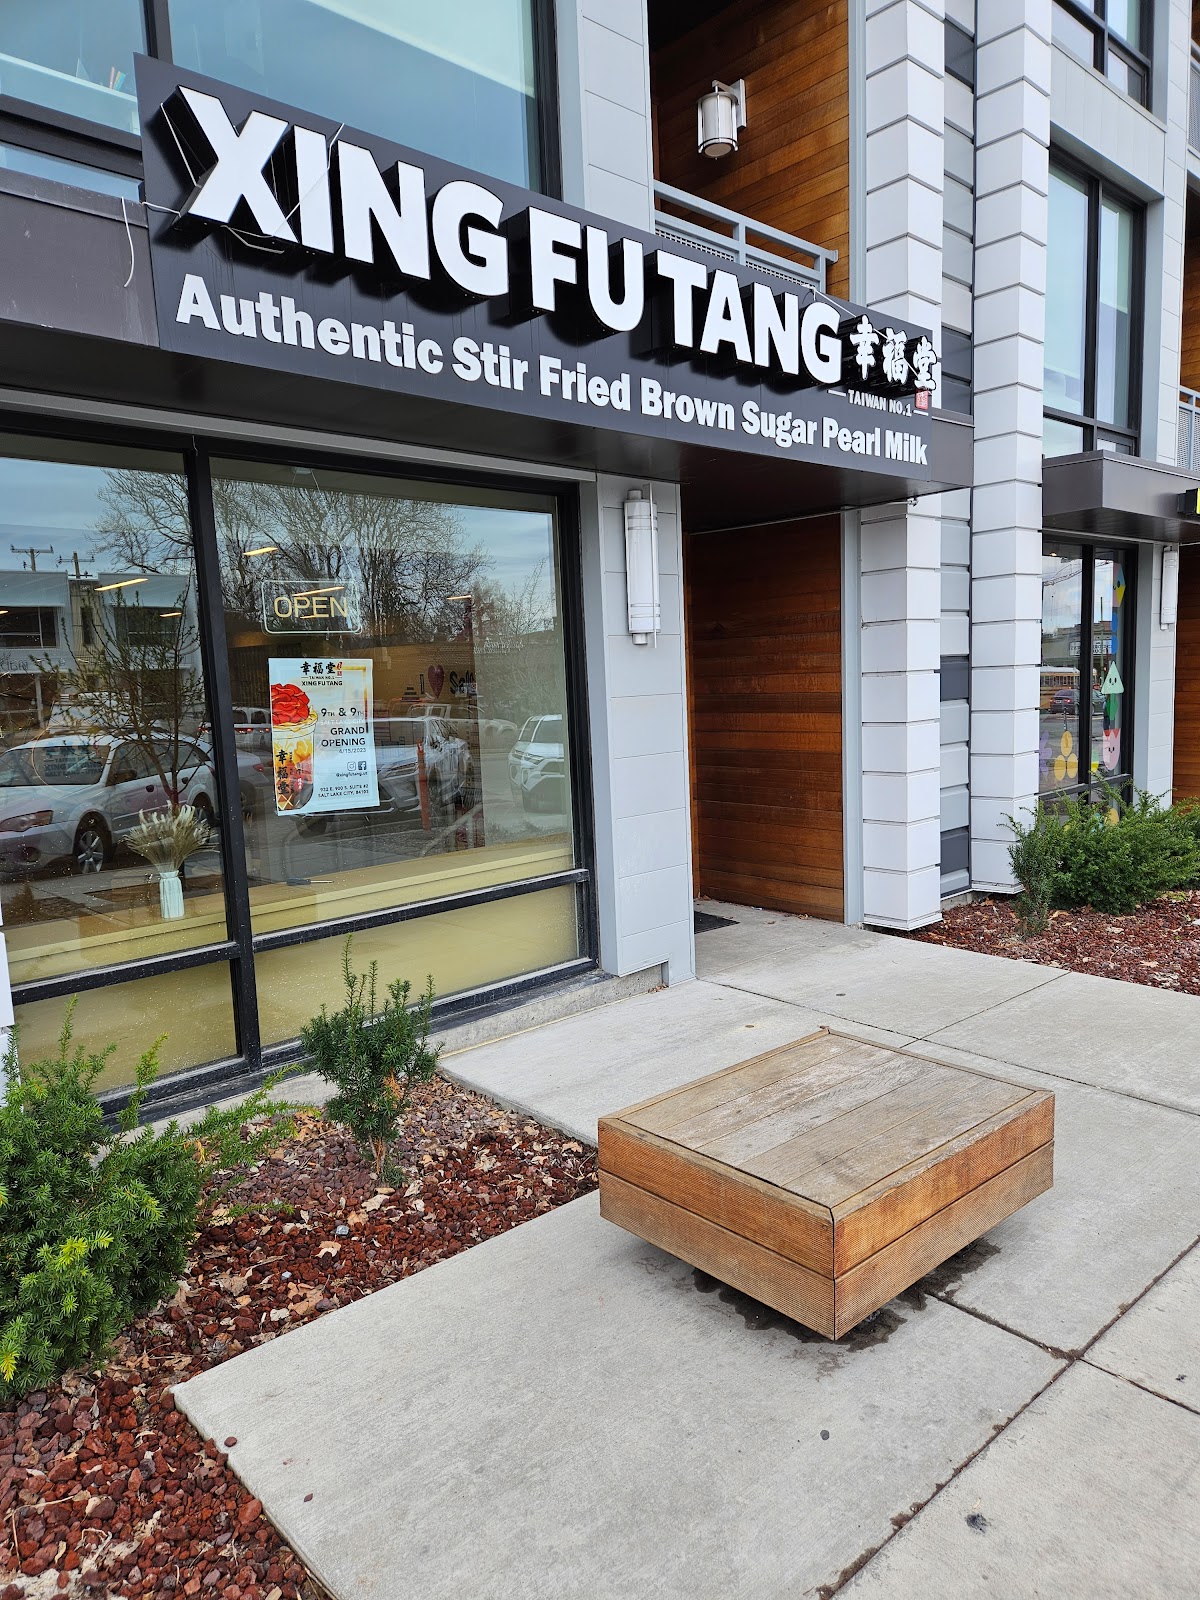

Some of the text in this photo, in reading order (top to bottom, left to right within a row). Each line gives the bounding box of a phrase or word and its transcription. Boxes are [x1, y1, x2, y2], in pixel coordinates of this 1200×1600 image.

[178, 85, 842, 385] XING FU TANG
[850, 314, 937, 390] 幸福堂
[175, 273, 928, 465] Authentic Stir Fried Brown Sugar Pearl Milk
[848, 389, 887, 411] TAIWAN
[888, 398, 912, 417] NO.1
[273, 596, 348, 618] OPEN
[300, 661, 336, 675] 幸福堂
[338, 707, 347, 717] &
[330, 726, 365, 735] GRAND
[321, 738, 366, 747] OPENING
